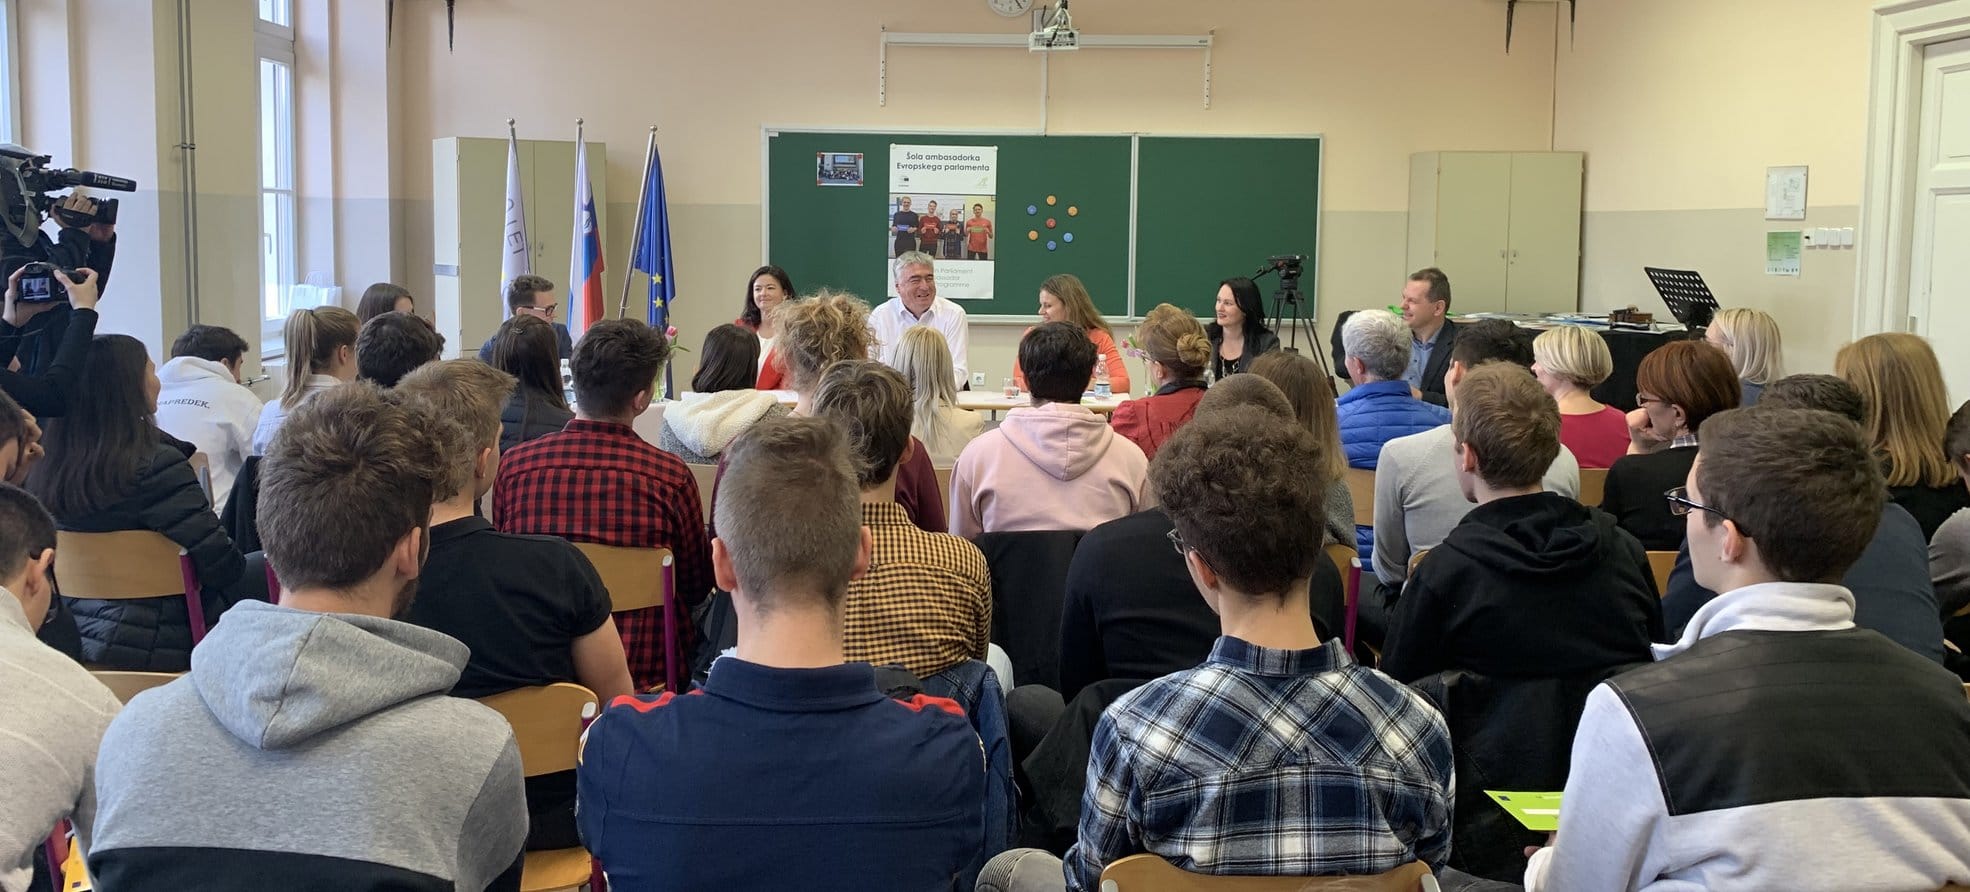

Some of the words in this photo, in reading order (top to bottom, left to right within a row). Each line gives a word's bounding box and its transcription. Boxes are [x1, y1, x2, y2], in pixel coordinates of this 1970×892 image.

[906, 151, 923, 160] Šola
[925, 153, 981, 162] ambasadorka
[896, 162, 943, 171] Evropskega
[944, 163, 990, 172] parlamenta
[940, 267, 973, 275] Parliament
